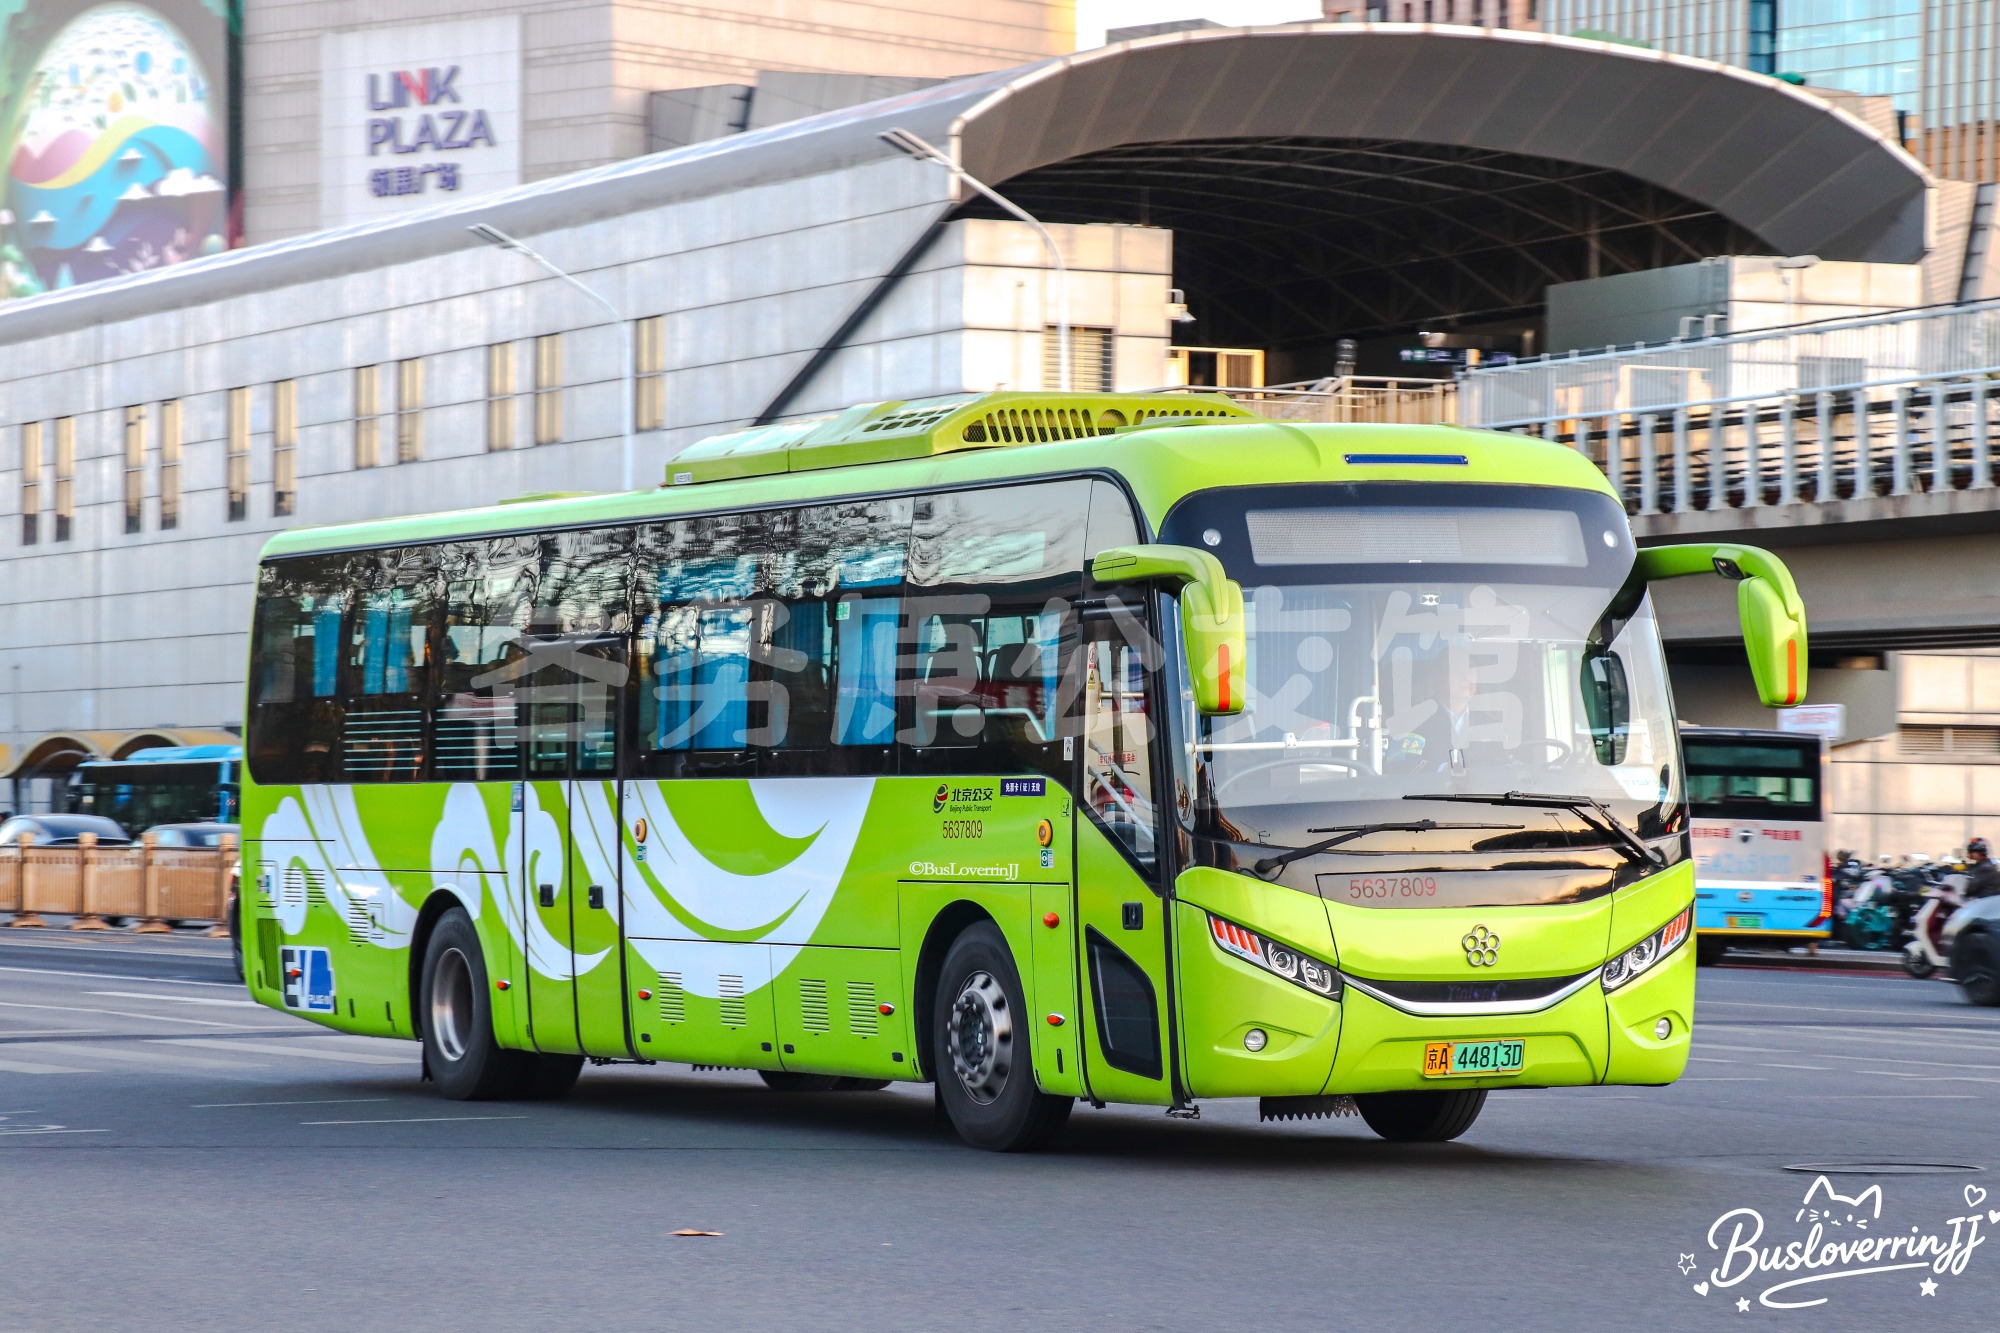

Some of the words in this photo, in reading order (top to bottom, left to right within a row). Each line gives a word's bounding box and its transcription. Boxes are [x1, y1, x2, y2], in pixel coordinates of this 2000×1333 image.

[366, 65, 461, 111] LINK
[366, 109, 497, 156] PLAZA
[951, 787, 994, 802] 北京公交
[949, 804, 962, 814] Beijing
[962, 804, 973, 813] Public
[973, 804, 992, 814] Transport
[942, 819, 983, 839] 5637809
[1350, 877, 1437, 899] 5637809
